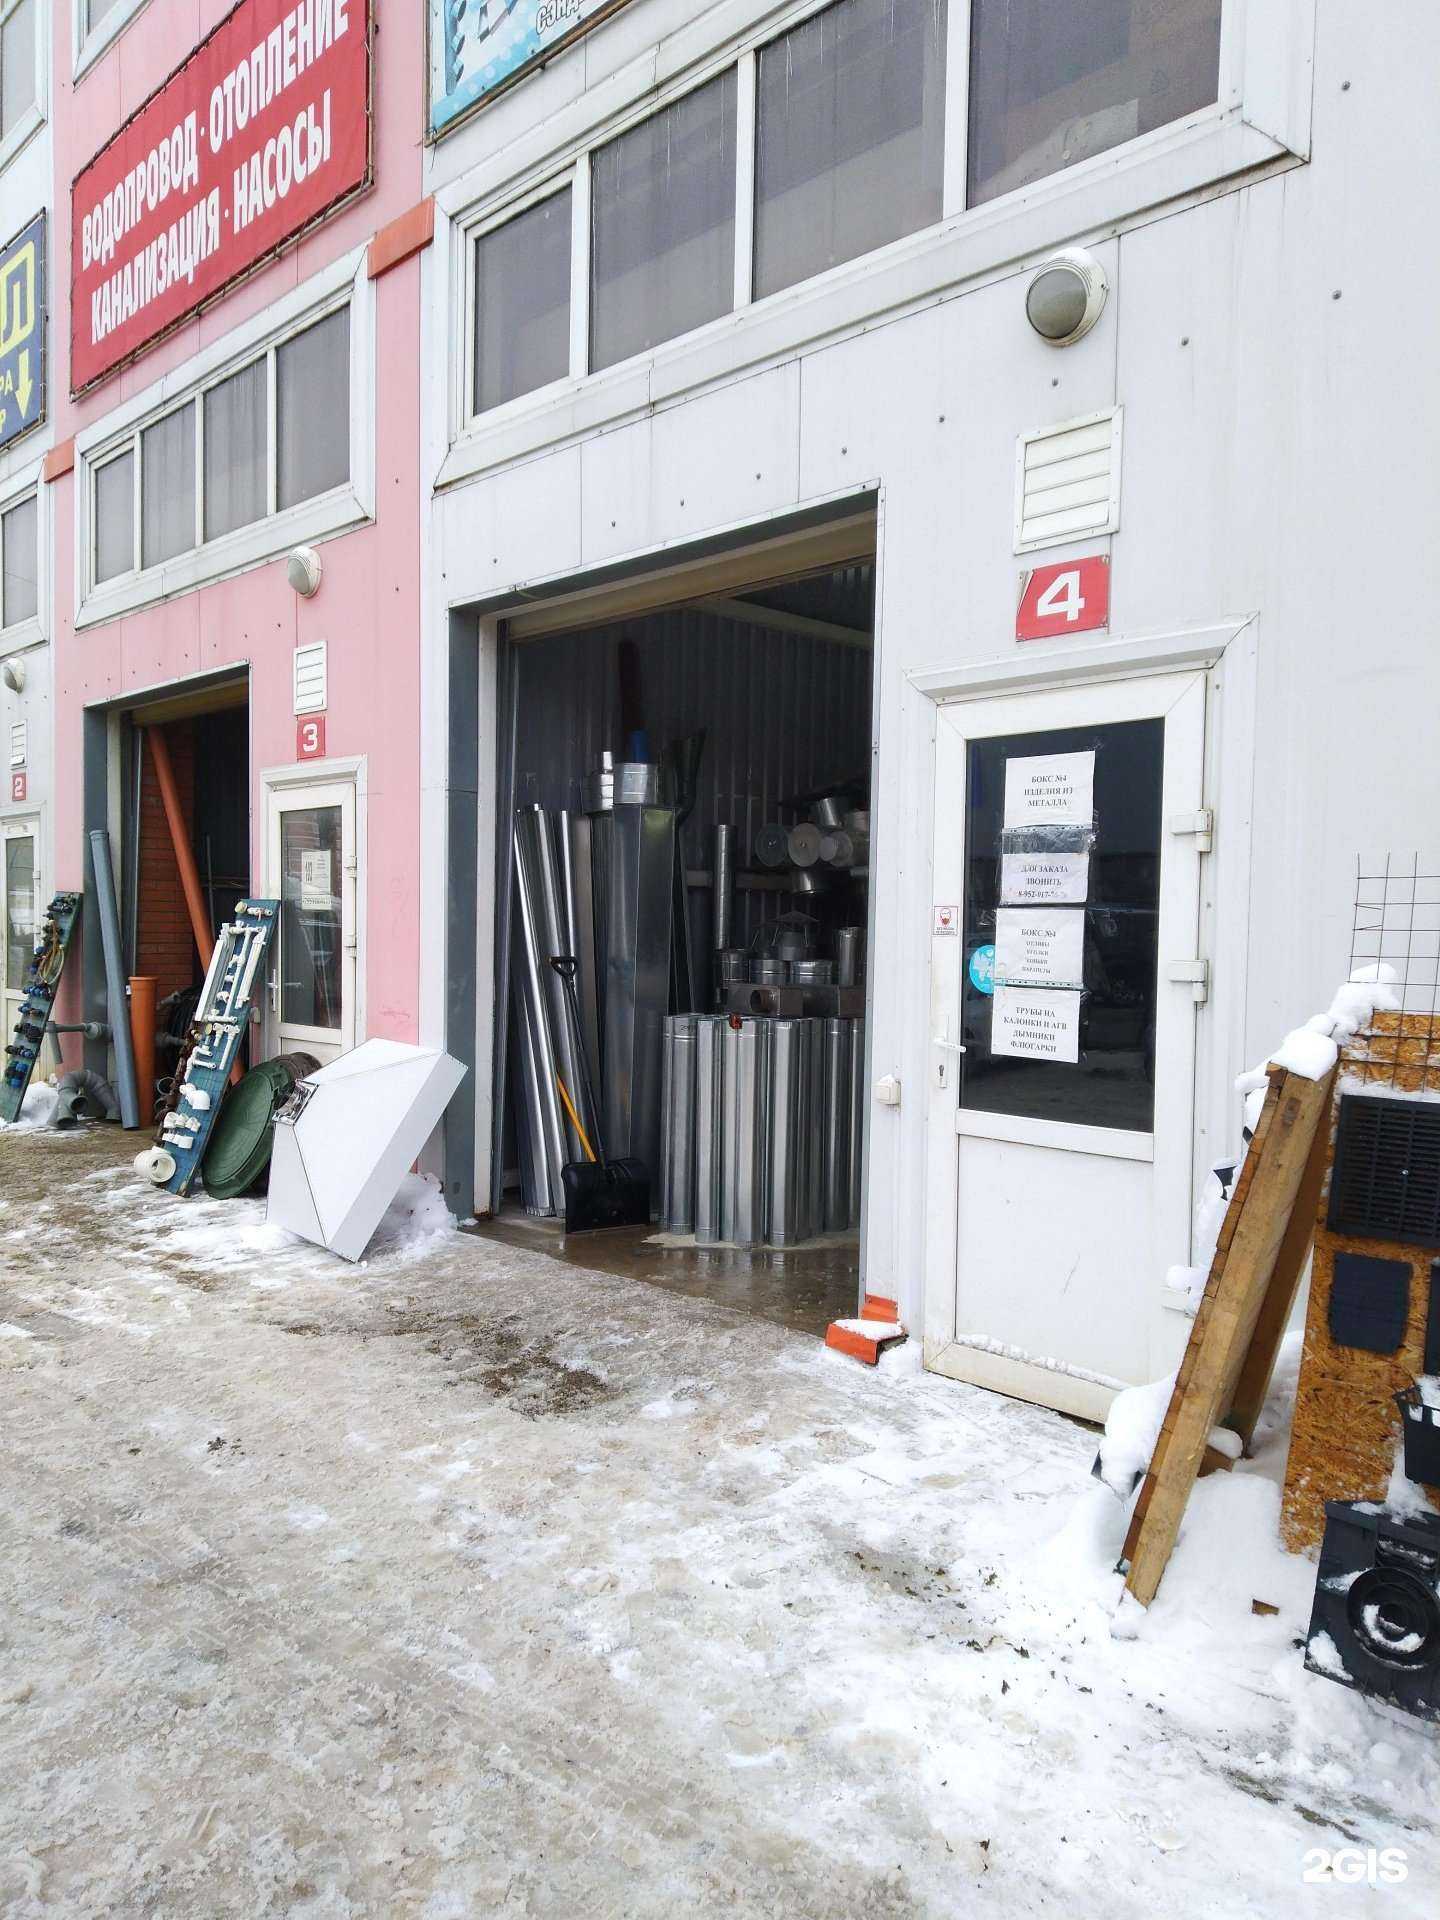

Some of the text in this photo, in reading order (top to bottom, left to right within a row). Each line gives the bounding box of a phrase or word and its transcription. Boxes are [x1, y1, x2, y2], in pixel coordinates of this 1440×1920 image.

[83, 0, 349, 272] ВОДОПРОВОД ОТОПЛЕНИЕ
[92, 88, 331, 345] КАНАЛИЗАЦИЯ НАСОСЫ
[1037, 570, 1085, 621] 4
[303, 723, 318, 752] 3
[1031, 775, 1054, 783] БОКС
[14, 777, 24, 797] 2
[1024, 788, 1061, 796] ИЗДЕЛИЯ
[1027, 799, 1068, 807] МЕТАЛЛА
[1038, 864, 1068, 873] ЗАКАЗА
[1026, 877, 1061, 886] ЗВОНИТЬ
[1021, 929, 1044, 937] БОКС
[1016, 1006, 1056, 1018] ТРУБЫ НА
[1012, 1030, 1056, 1041] ДЫМНИКИ
[1010, 1040, 1057, 1053] ФЛЮГАРКИ
